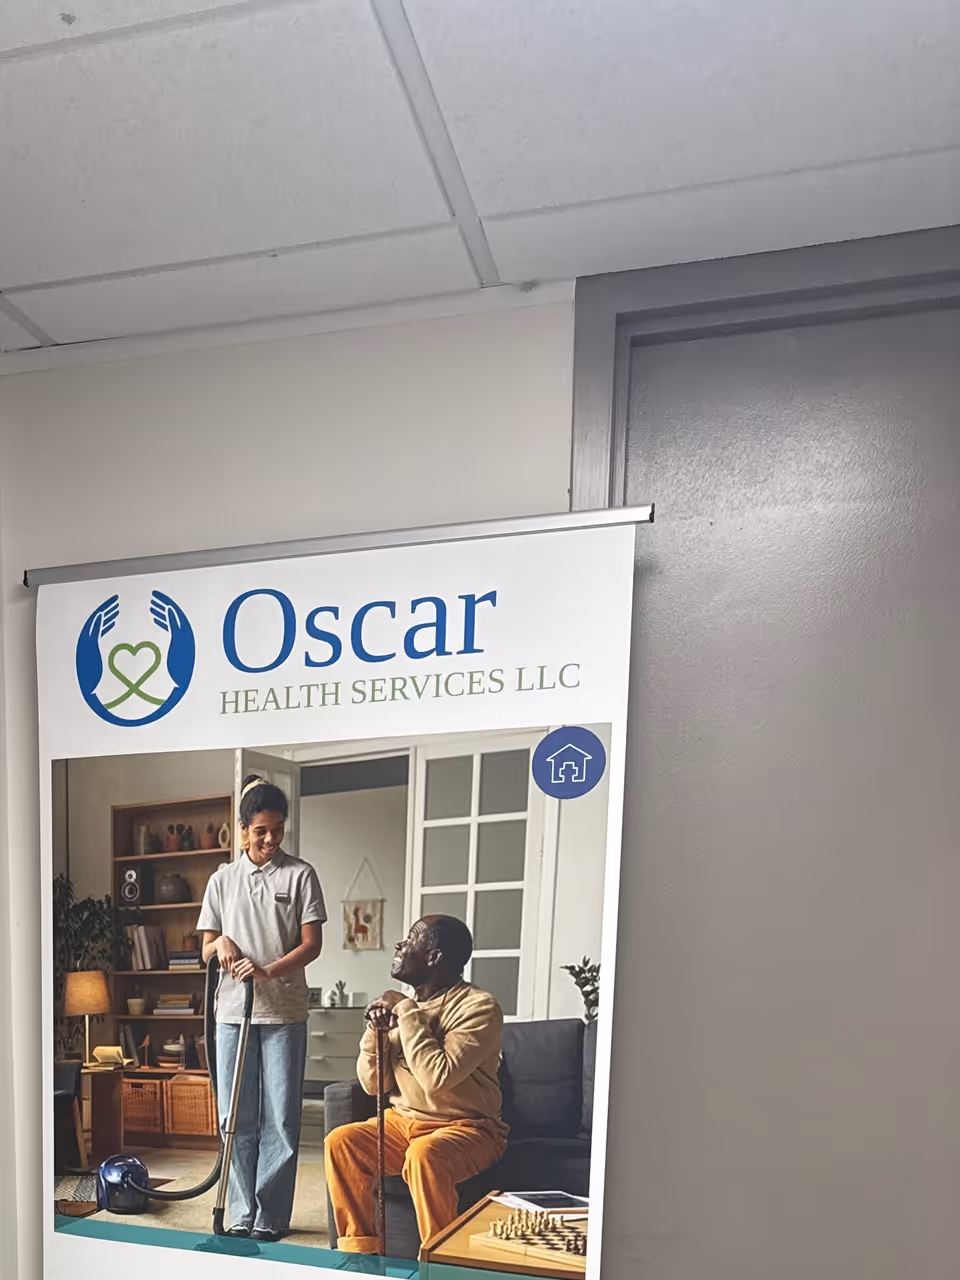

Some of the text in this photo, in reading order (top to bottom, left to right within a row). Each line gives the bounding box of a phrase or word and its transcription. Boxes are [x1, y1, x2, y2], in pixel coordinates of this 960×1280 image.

[222, 588, 498, 674] Oscar
[219, 663, 581, 715] HEALTH SERVICES LLC
